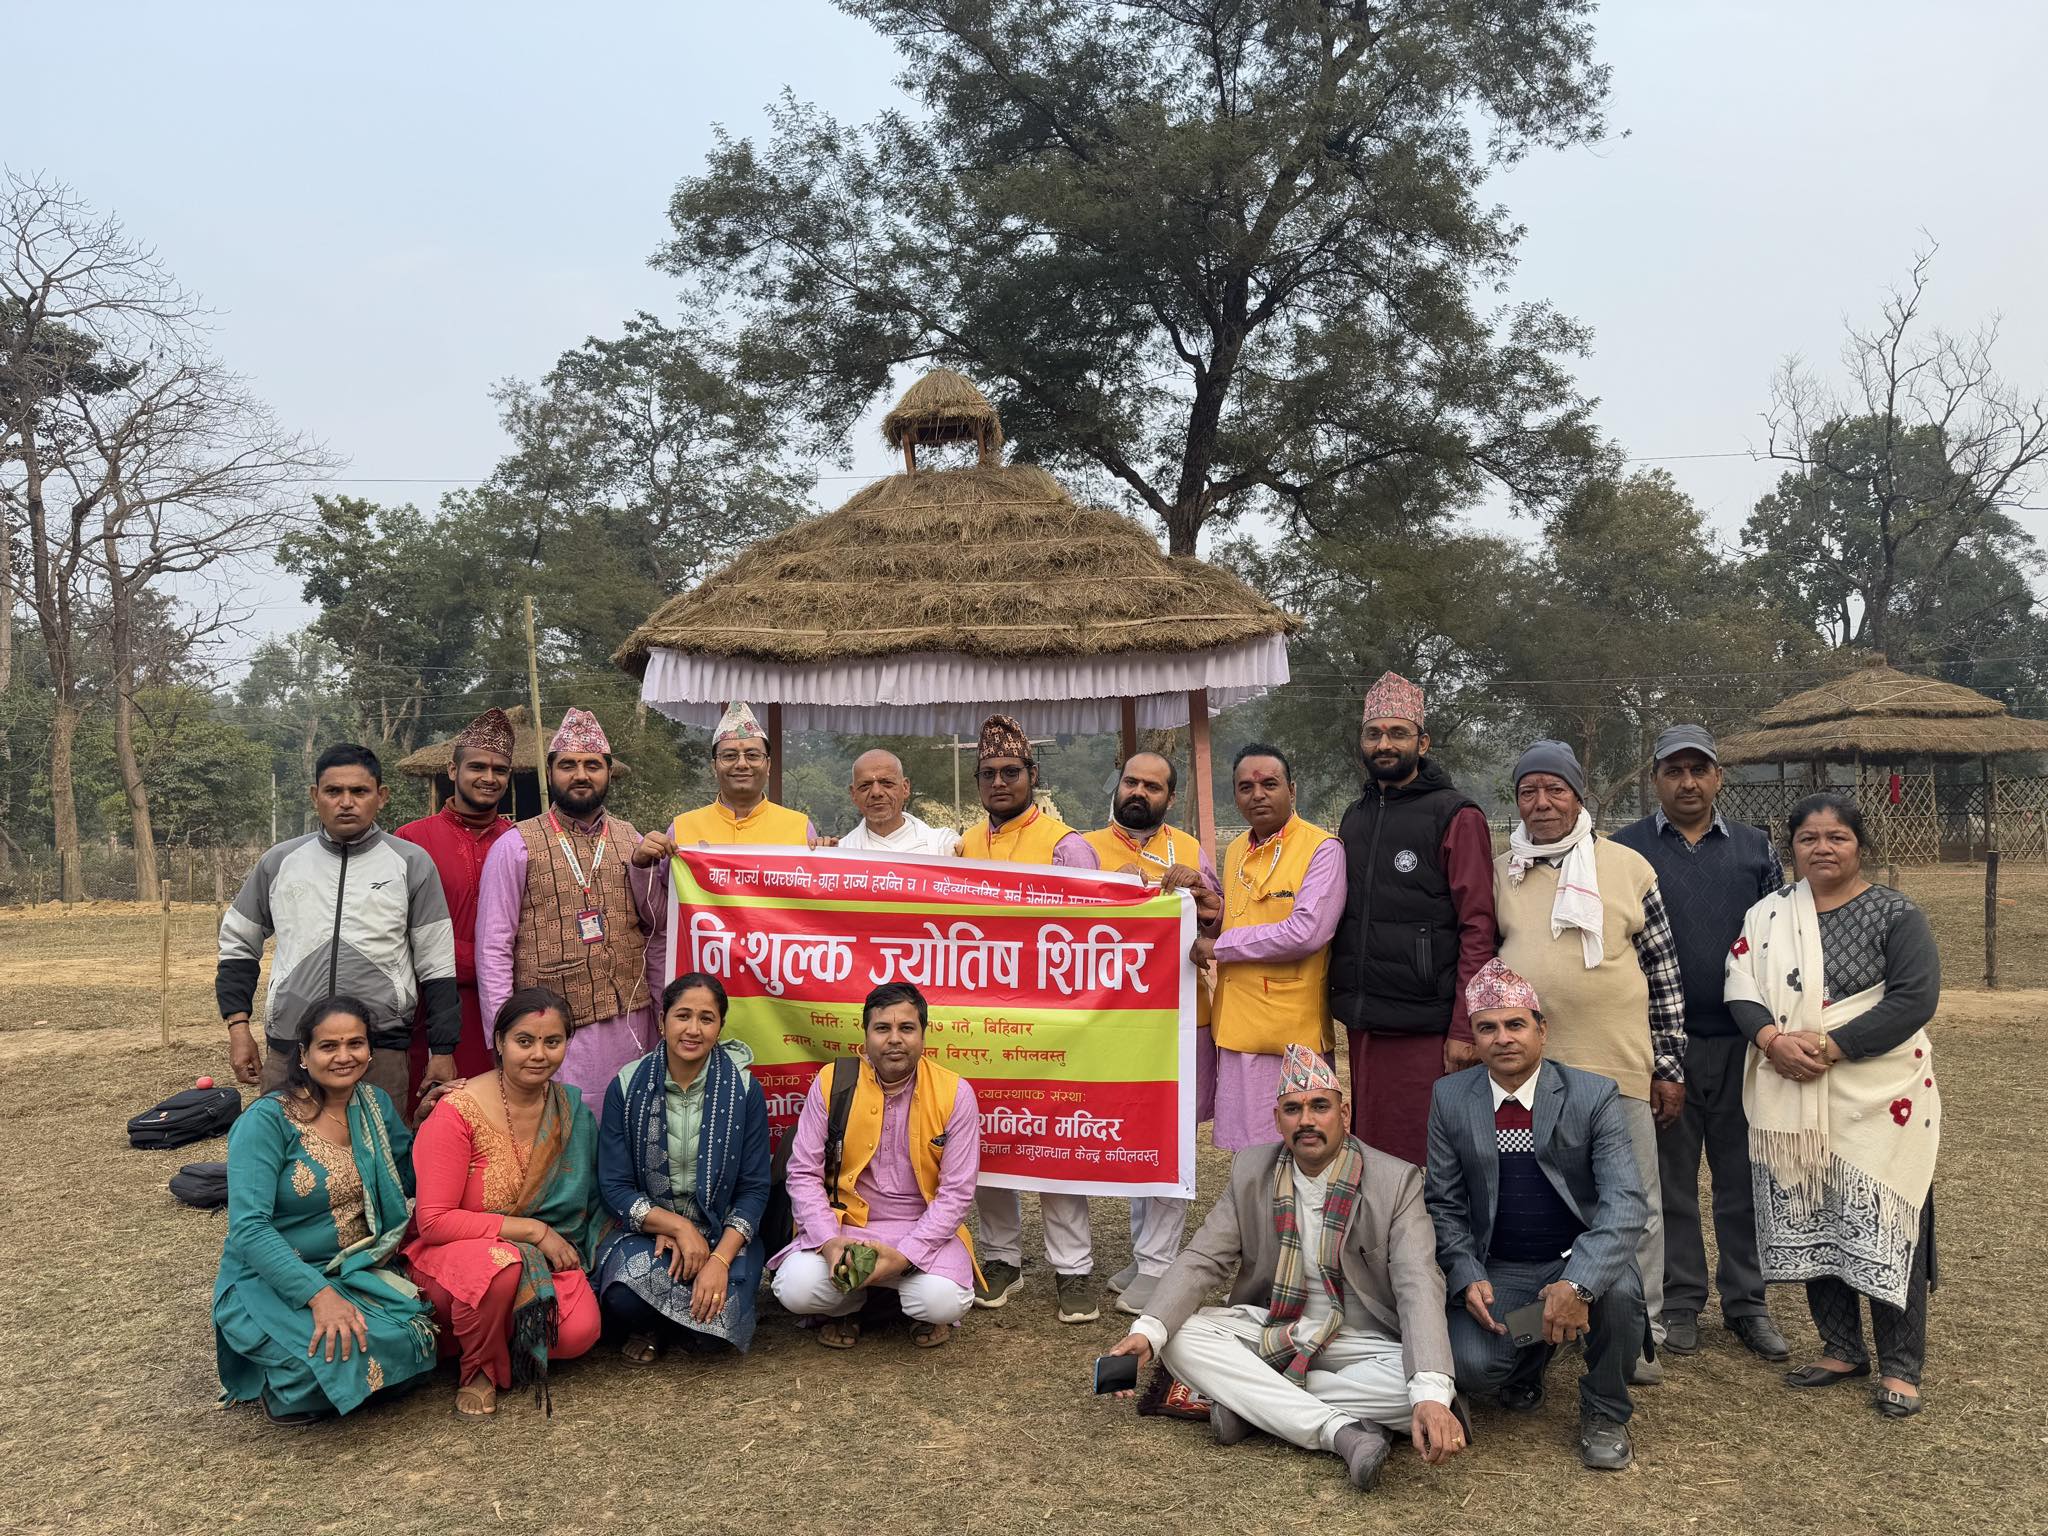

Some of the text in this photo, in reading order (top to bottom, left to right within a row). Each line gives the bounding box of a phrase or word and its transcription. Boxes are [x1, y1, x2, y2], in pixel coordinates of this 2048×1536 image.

[708, 867, 730, 886] ग्रहा
[734, 865, 760, 886] राज्यं
[843, 870, 869, 890] राज्यं
[871, 872, 904, 893] हरन्ति
[907, 878, 916, 891] च
[868, 921, 1023, 991] ज्योतिष
[1037, 923, 1154, 995] शिविर
[984, 1017, 1034, 1037] बिहिबार
[822, 1039, 841, 1052] यज्ञ
[1002, 1045, 1066, 1067] कपिलवस्तु
[757, 1072, 801, 1087] योजक
[978, 1089, 1045, 1101] व्यवस्थापक
[978, 1106, 1124, 1142] शनिदेव मन्दिर
[1075, 1145, 1101, 1164] केन्द्र
[1105, 1147, 1160, 1166] कपिलवस्तु
